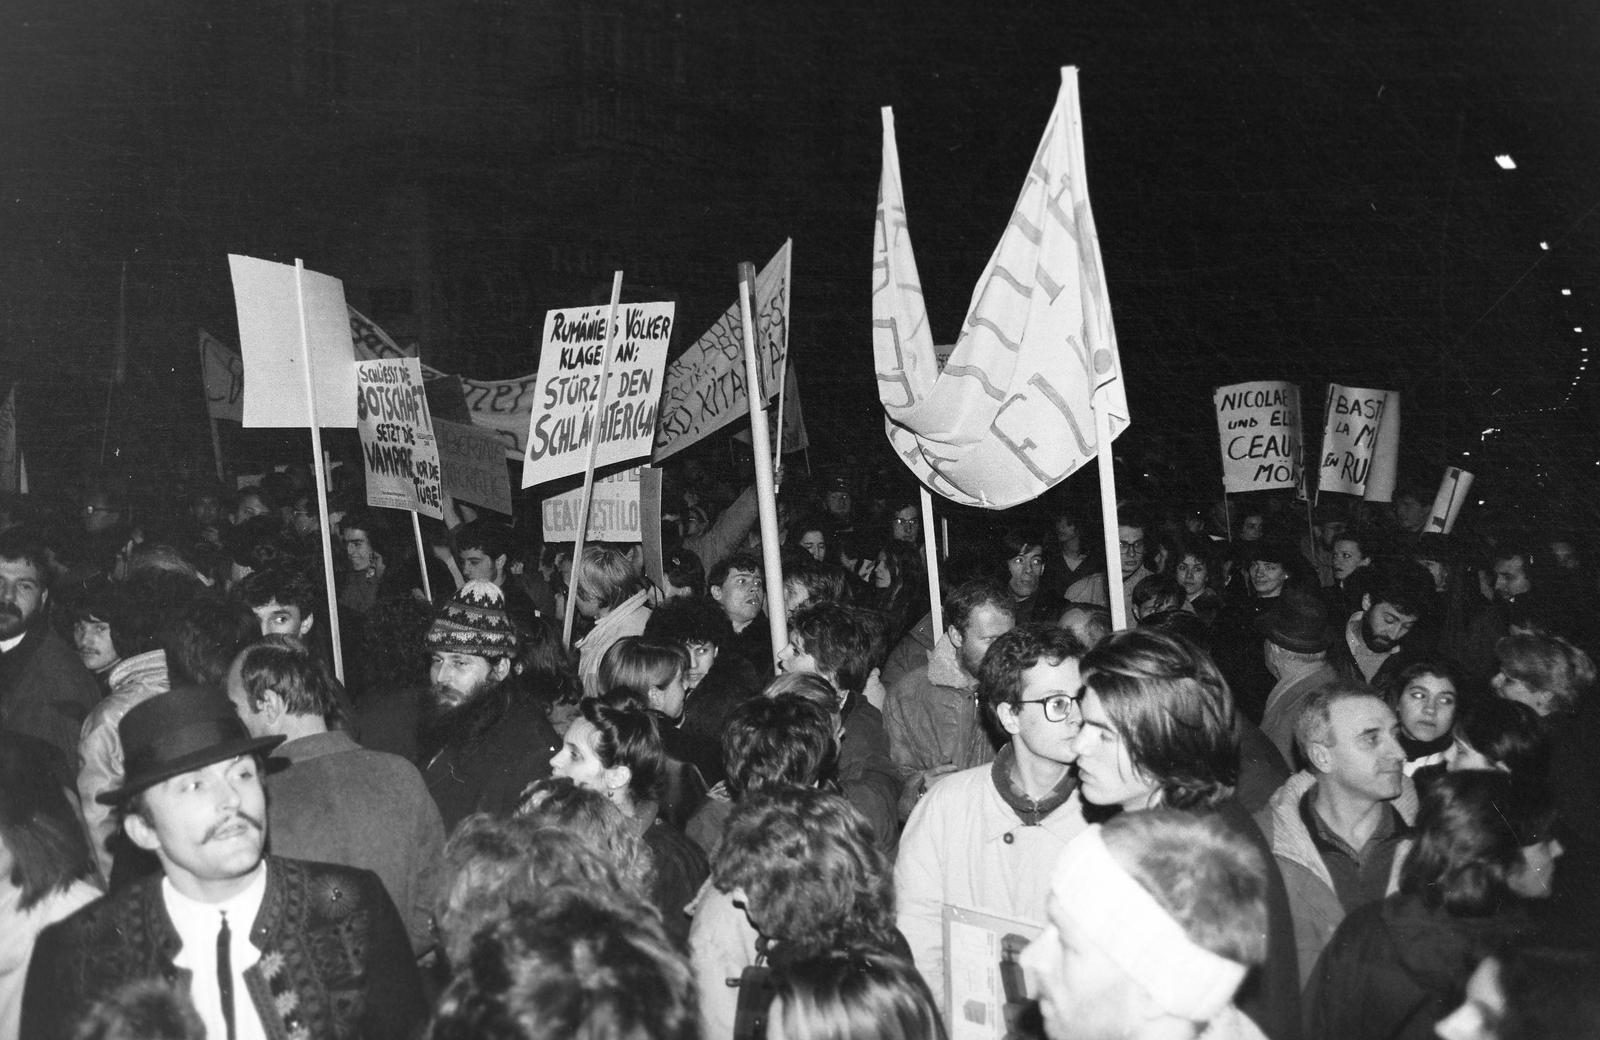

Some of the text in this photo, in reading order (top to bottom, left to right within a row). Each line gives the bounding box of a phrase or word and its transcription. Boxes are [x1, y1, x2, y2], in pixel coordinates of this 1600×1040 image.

[550, 309, 619, 343] RUMÄNIES
[625, 308, 671, 340] VÖLKER
[559, 345, 605, 370] KLAGE
[617, 368, 653, 398] DEN
[376, 422, 400, 443] SETZT
[1228, 417, 1258, 430] UND
[1335, 423, 1350, 436] LA
